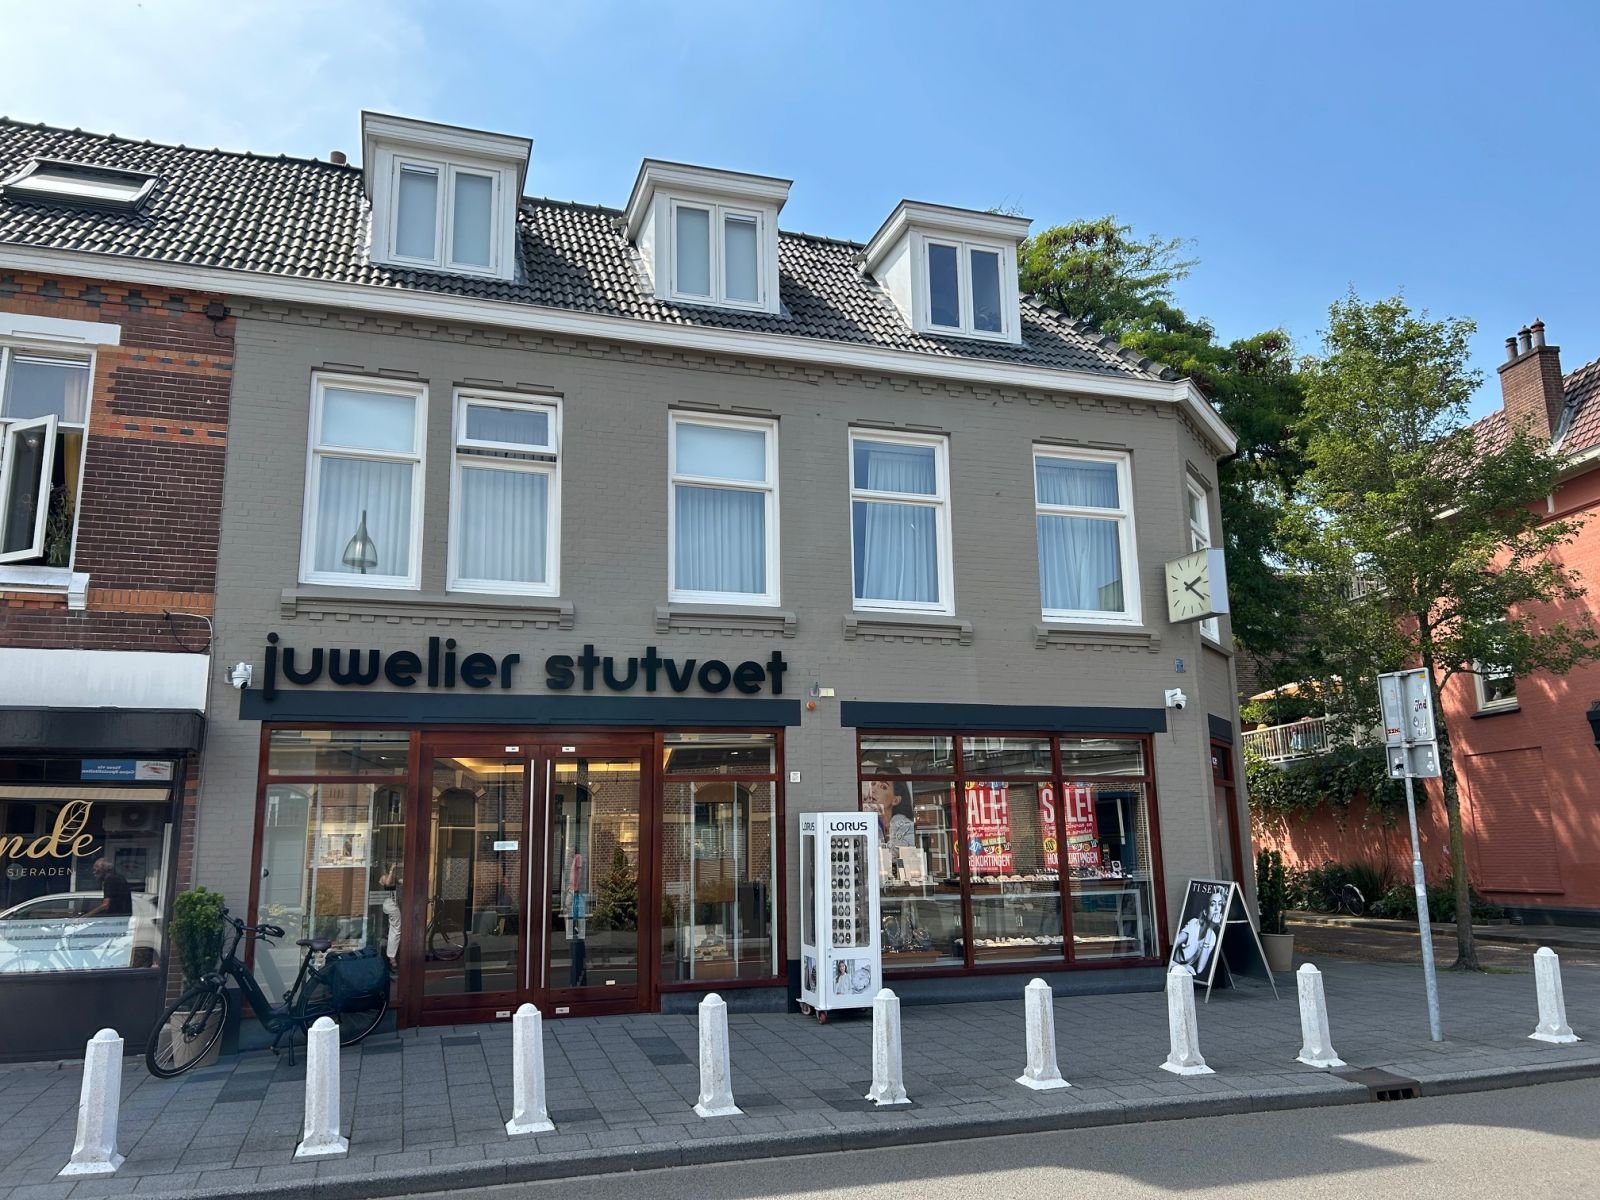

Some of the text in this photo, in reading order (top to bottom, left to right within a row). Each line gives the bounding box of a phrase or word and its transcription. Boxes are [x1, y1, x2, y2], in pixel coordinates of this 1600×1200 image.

[263, 632, 788, 701] juwelier stutvoet
[965, 789, 1008, 825] ALE!
[1042, 788, 1093, 824] SLE!
[802, 822, 815, 831] LORUS
[830, 821, 868, 831] LORUS
[7, 867, 76, 877] SIERADEN
[1192, 883, 1201, 892] TI
